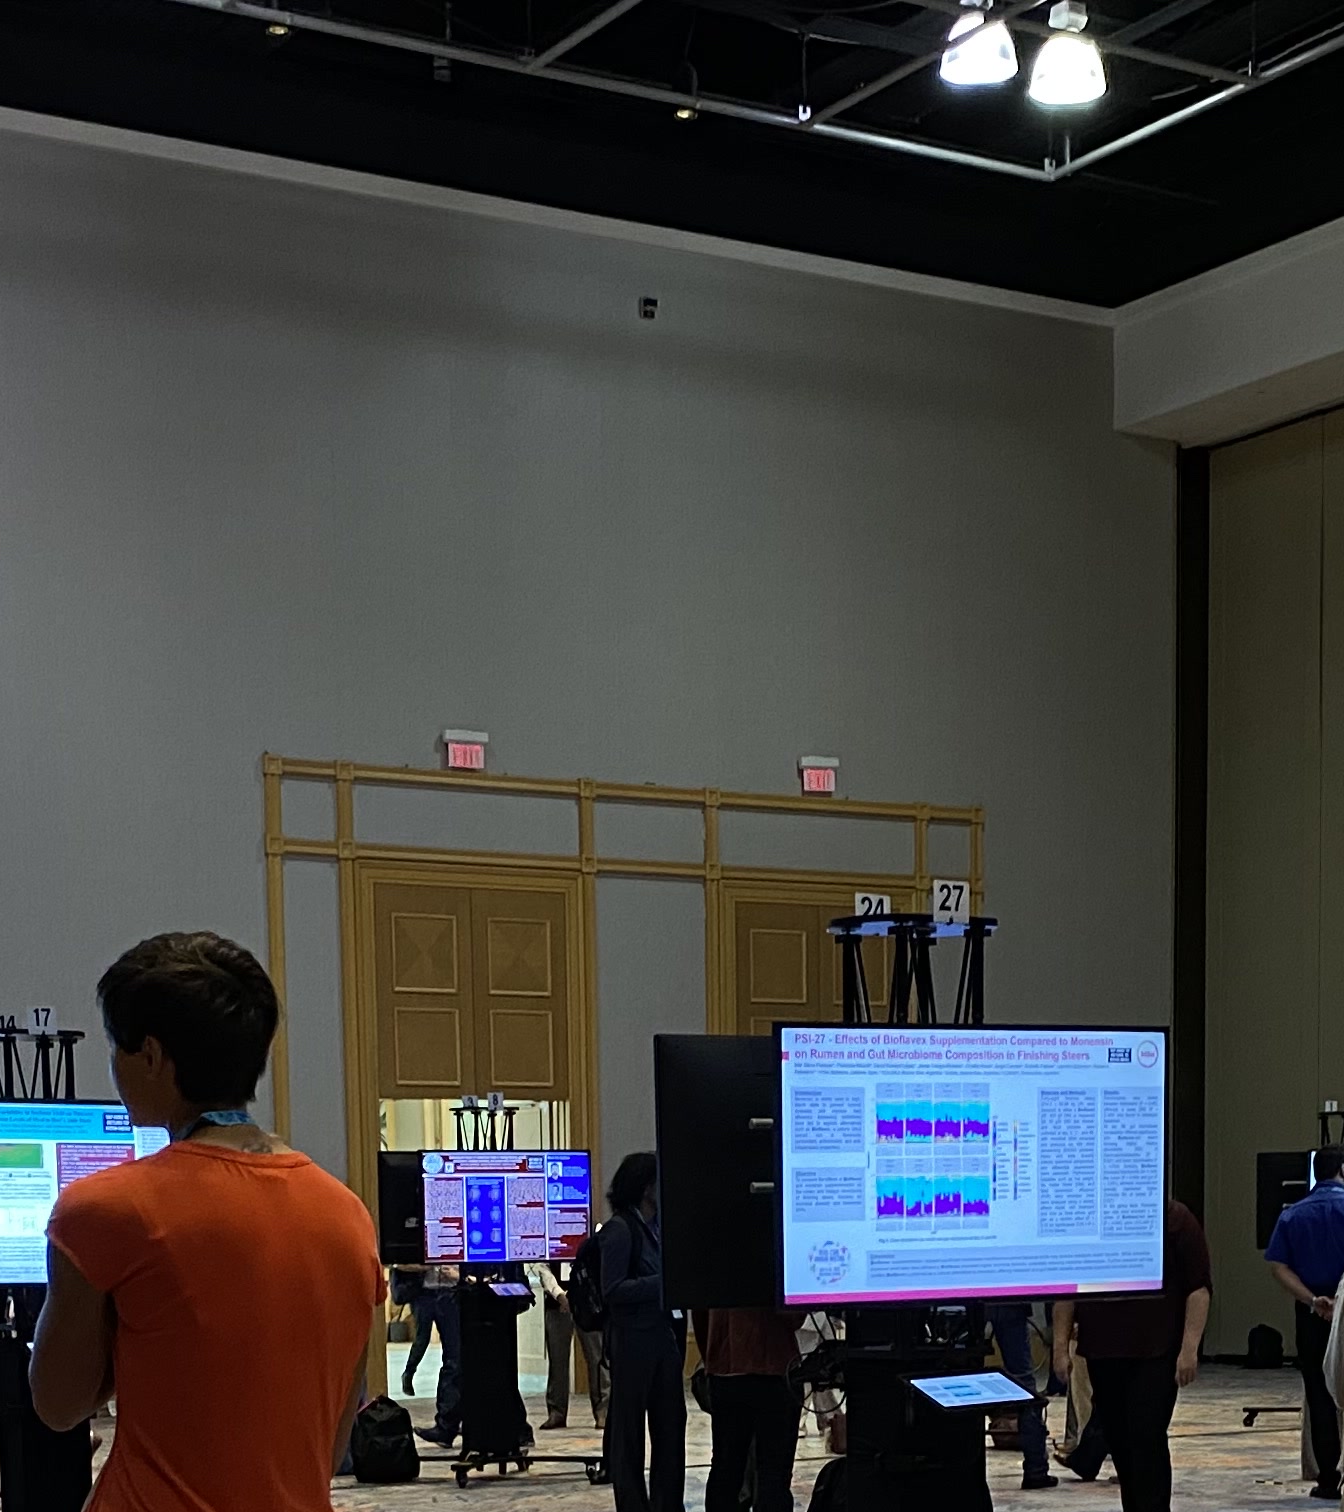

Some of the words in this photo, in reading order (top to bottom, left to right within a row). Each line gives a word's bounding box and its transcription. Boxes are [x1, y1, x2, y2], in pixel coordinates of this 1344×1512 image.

[939, 884, 964, 912] 27
[33, 1008, 51, 1026] 17
[795, 1033, 825, 1044] PSI-27
[835, 1033, 868, 1044] Effects
[871, 1033, 880, 1044] of
[929, 1035, 1007, 1048] Supplementation
[1010, 1036, 1057, 1048] Compared
[1059, 1037, 1068, 1046] to
[795, 1051, 807, 1059] on
[810, 1049, 845, 1059] Rumen
[847, 1050, 865, 1059] and
[868, 1049, 885, 1059] Gut
[887, 1050, 943, 1060] Microbiome
[945, 1050, 1004, 1062] Composition
[1006, 1051, 1015, 1060] in
[1017, 1051, 1059, 1063] Finishing
[1061, 1051, 1090, 1061] Steers
[492, 1094, 499, 1106] 8
